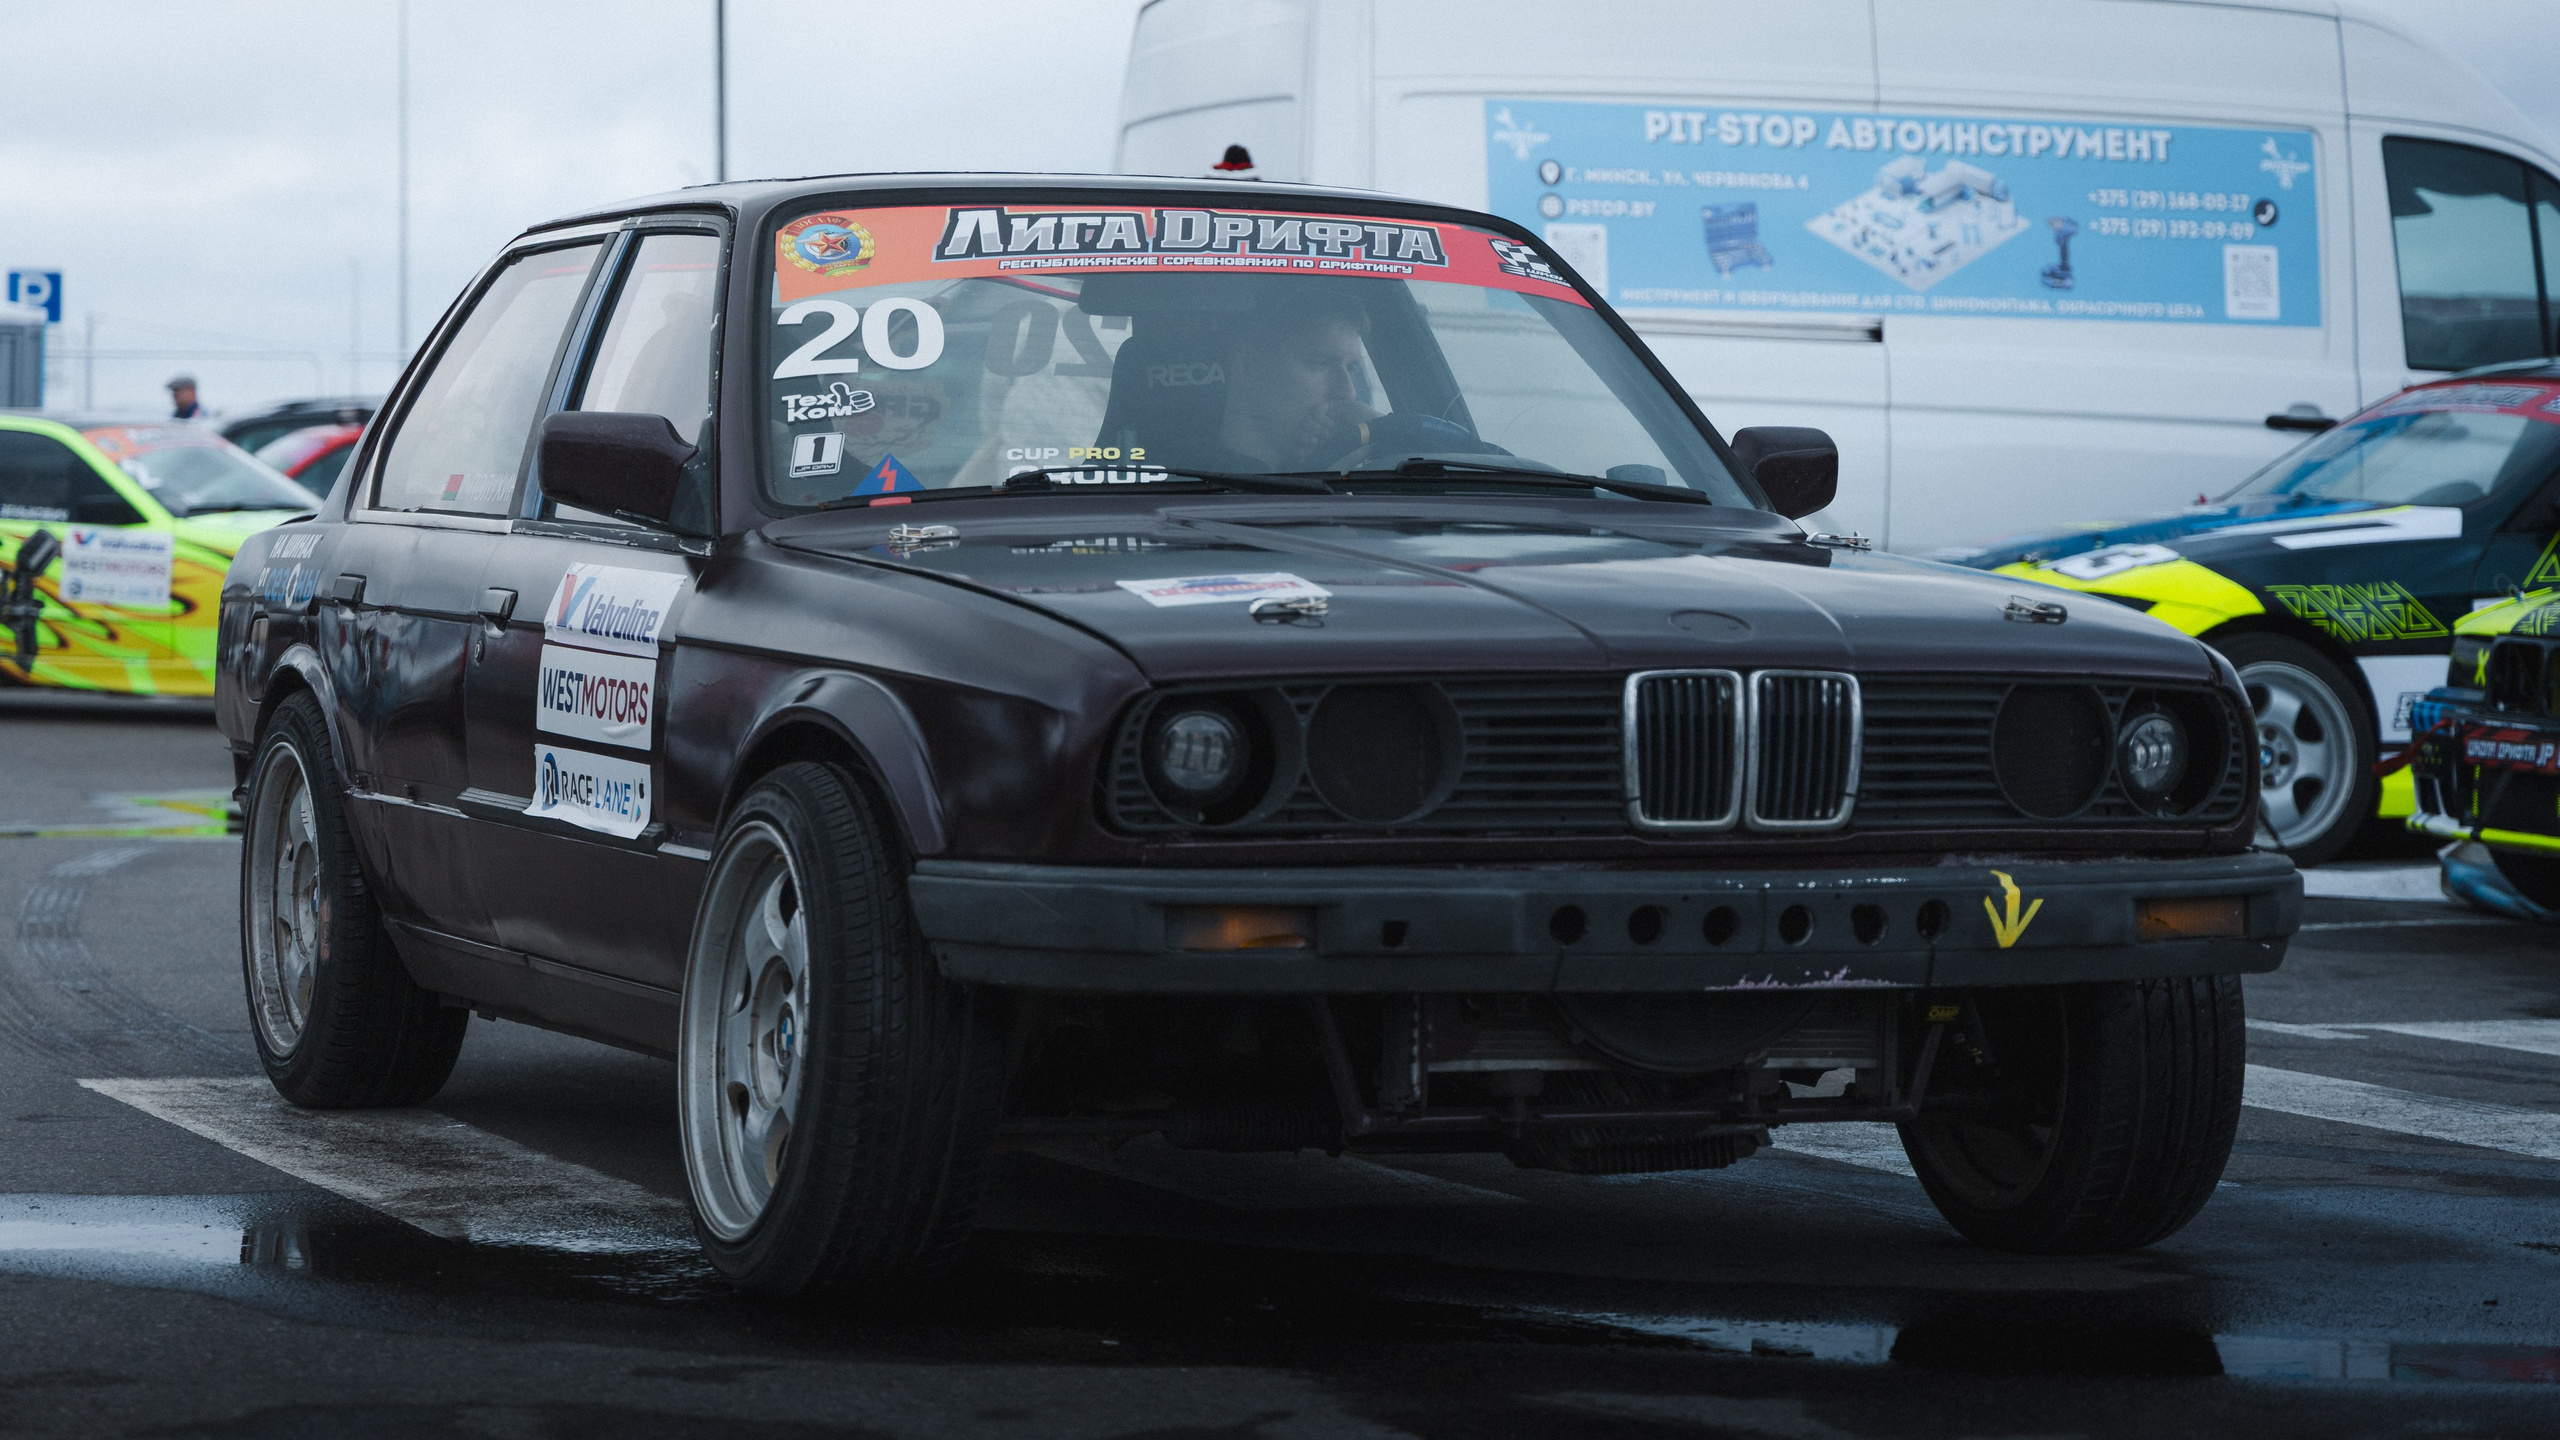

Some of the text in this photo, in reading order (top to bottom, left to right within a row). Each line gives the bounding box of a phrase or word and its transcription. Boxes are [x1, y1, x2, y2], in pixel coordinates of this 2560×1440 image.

[1644, 111, 2173, 162] PIT-STOP АВТОИНСТРУМЕНТ
[1566, 199, 1656, 218] PSTOP.BY
[2087, 188, 2129, 208] +375
[2089, 217, 2130, 236] +375
[999, 256, 1414, 274] РЕСПУБЛИКАНСКИЕ СОРЕВНОВАНИЯ ПО ДРИФТИНГУ
[17, 272, 52, 306] P
[773, 297, 945, 380] 20
[812, 436, 826, 463] 1
[1006, 447, 1146, 461] CUP PRO 2
[269, 534, 323, 558] НА ШИНАХ
[582, 593, 659, 643] Valvoline
[543, 666, 649, 726] WESTMOTORS
[2536, 742, 2555, 767] JP
[561, 770, 593, 806] RACE
[594, 777, 631, 815] LANE
